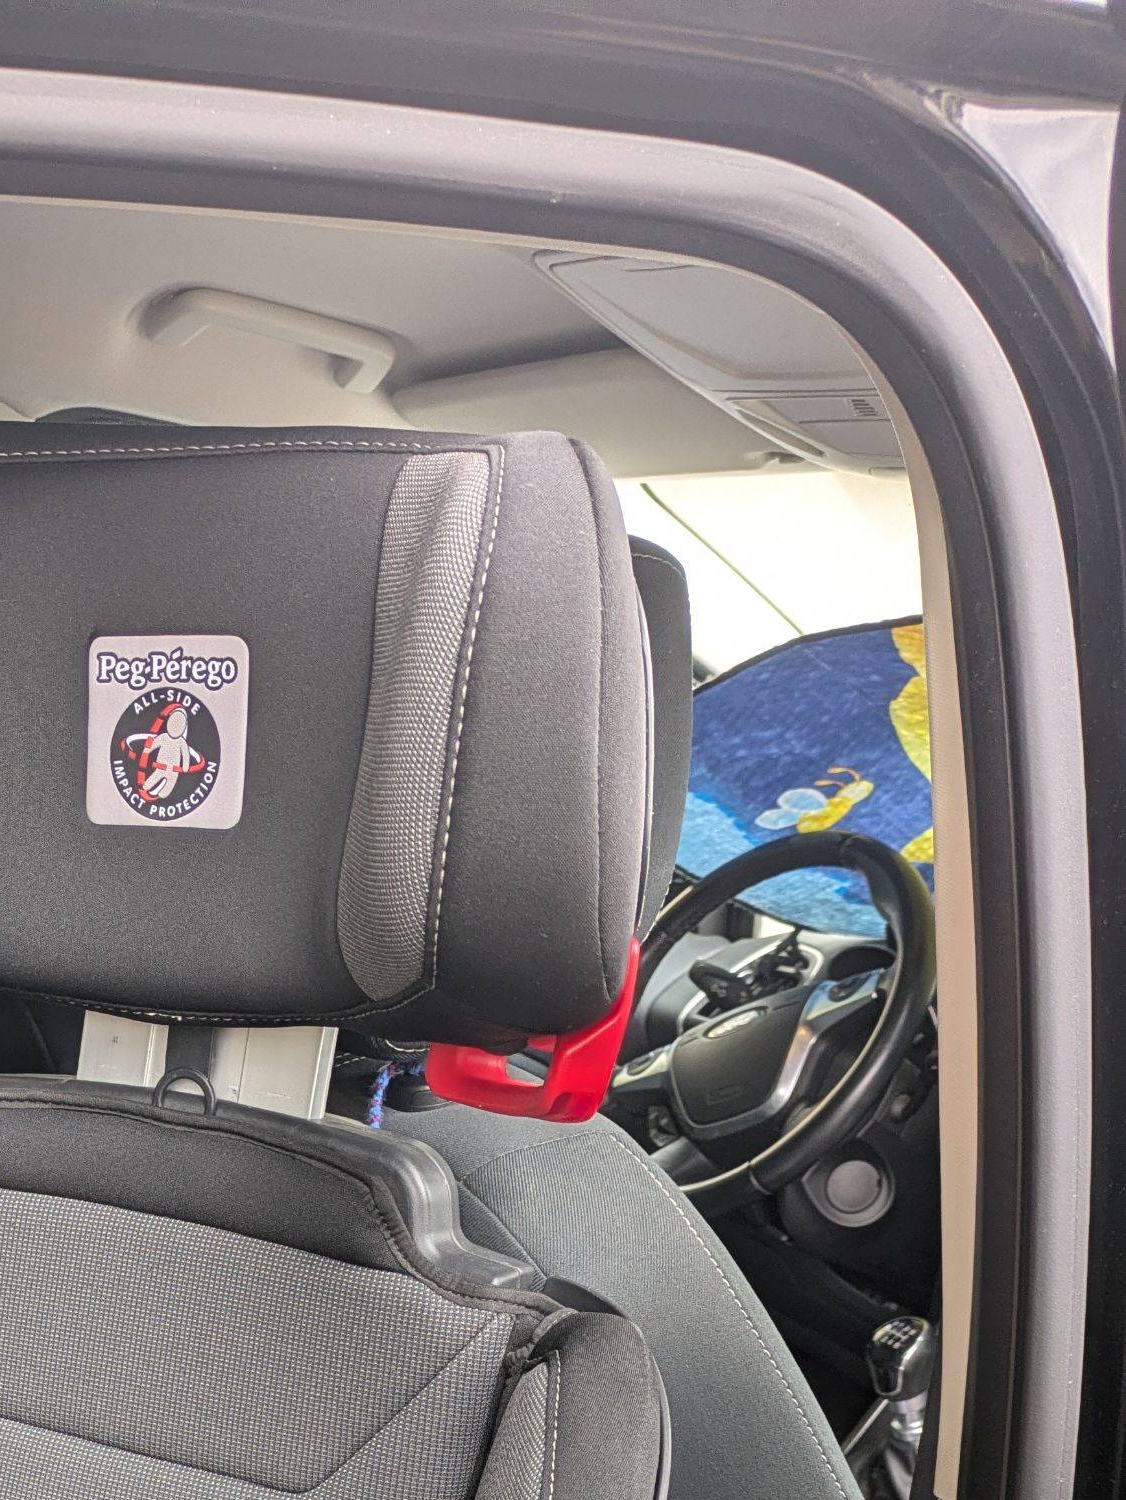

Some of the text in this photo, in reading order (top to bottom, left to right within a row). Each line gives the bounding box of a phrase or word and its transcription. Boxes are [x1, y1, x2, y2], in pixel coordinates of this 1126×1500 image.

[133, 689, 201, 716] ALL-SIDE
[113, 759, 218, 818] IMPACT PROTECTION
